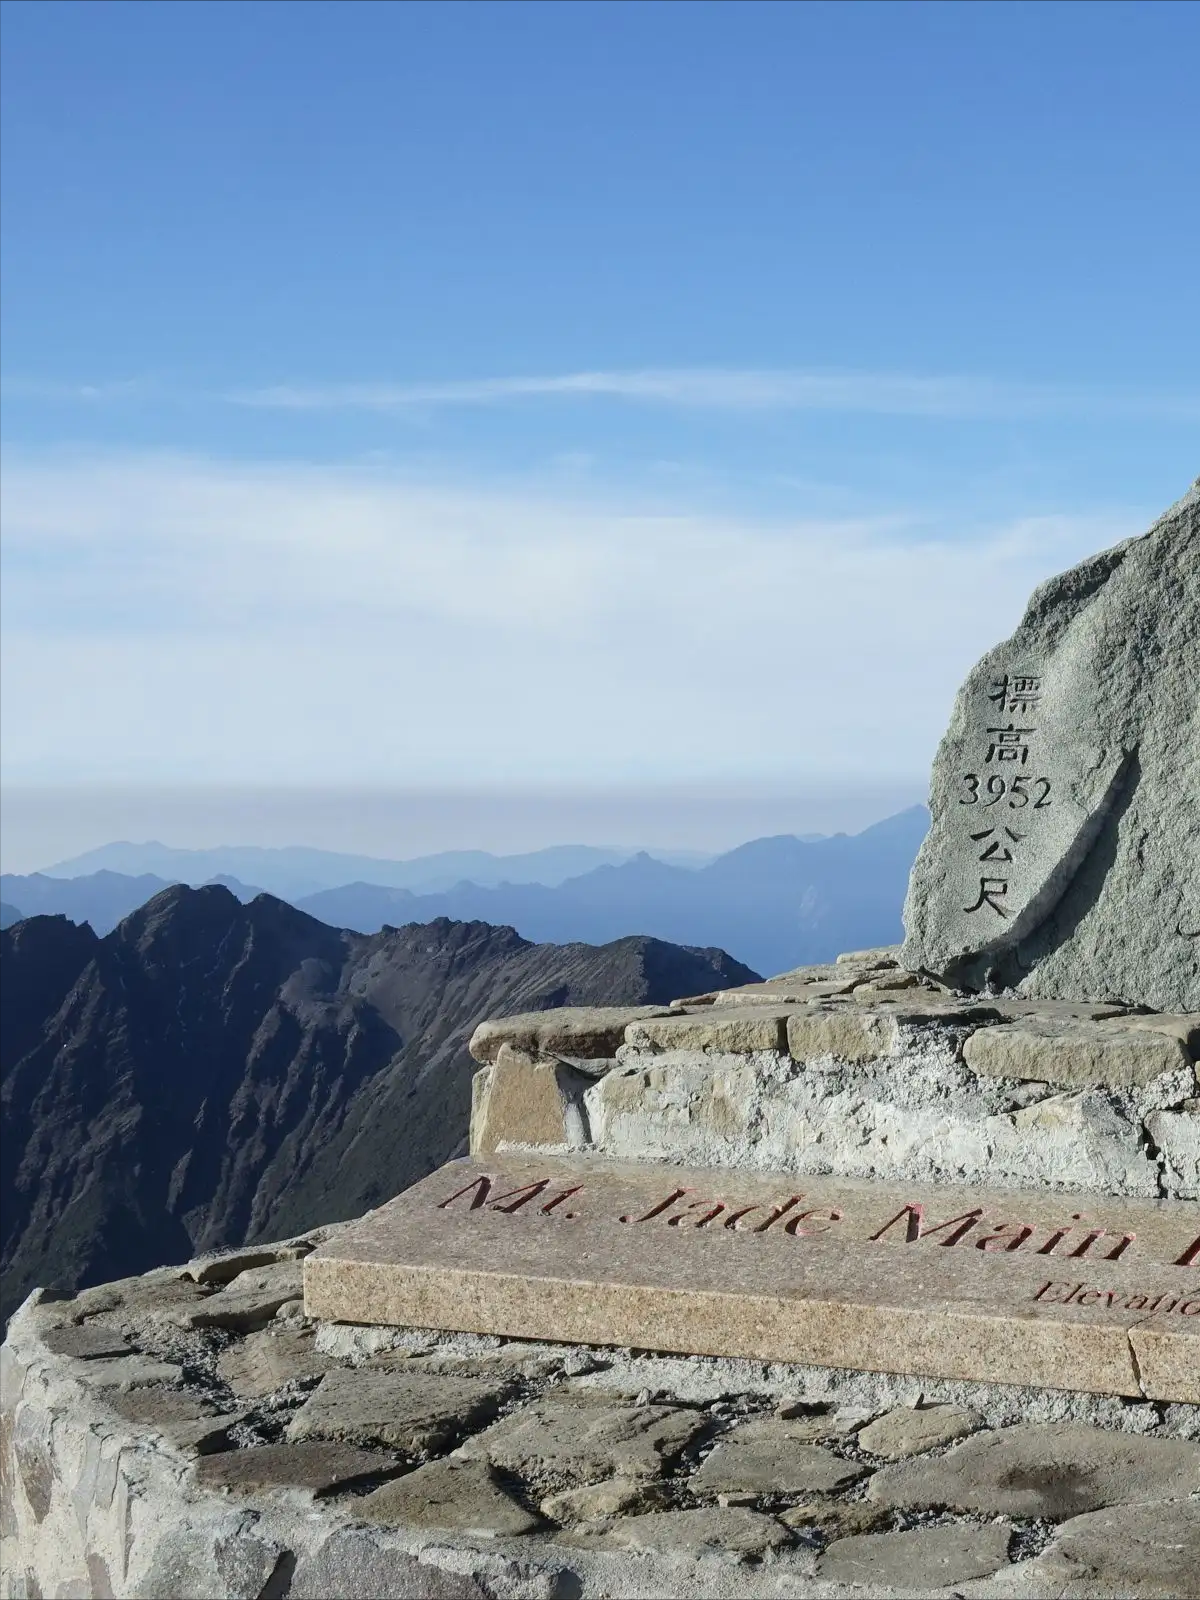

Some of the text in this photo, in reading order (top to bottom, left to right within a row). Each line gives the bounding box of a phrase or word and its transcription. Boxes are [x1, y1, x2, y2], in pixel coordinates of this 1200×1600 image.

[437, 1175, 584, 1219] Mt.
[618, 1187, 841, 1236] Jade
[866, 1203, 1137, 1262] Main
